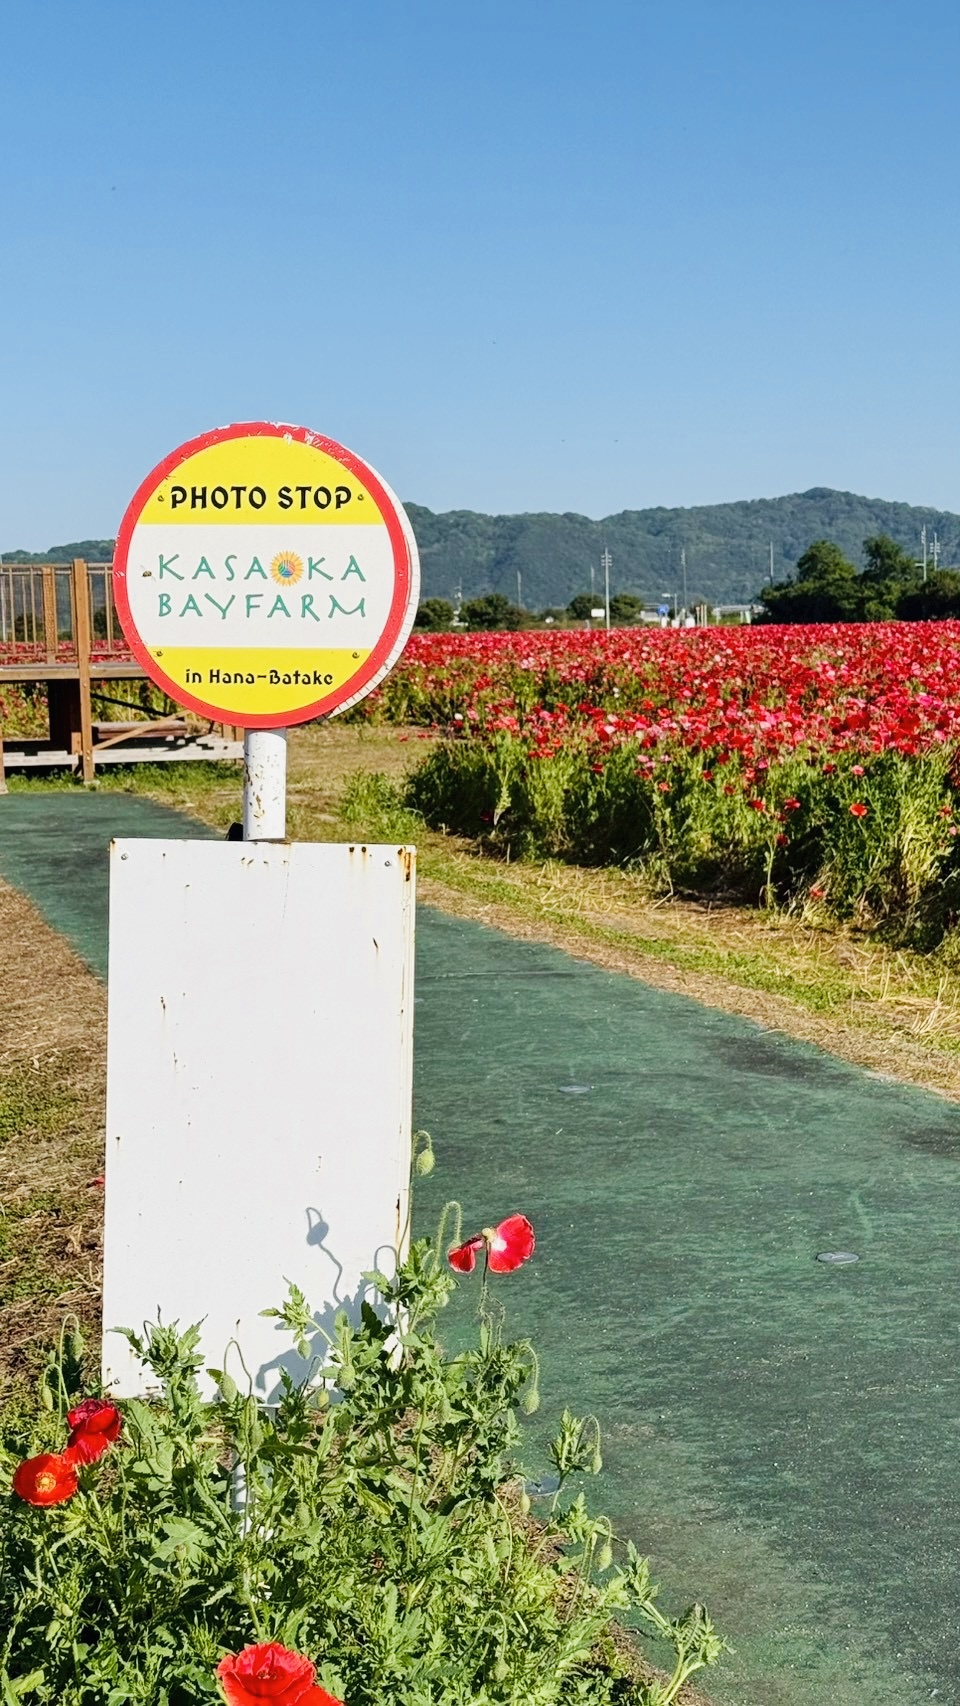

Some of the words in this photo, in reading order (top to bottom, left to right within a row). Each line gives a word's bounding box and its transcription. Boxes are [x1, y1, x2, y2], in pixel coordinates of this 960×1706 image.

[170, 486, 267, 510] PHOTO
[277, 486, 352, 510] STOP
[158, 593, 366, 622] BAYFARM
[185, 669, 202, 684] in
[209, 669, 333, 685] Hana-Batake
